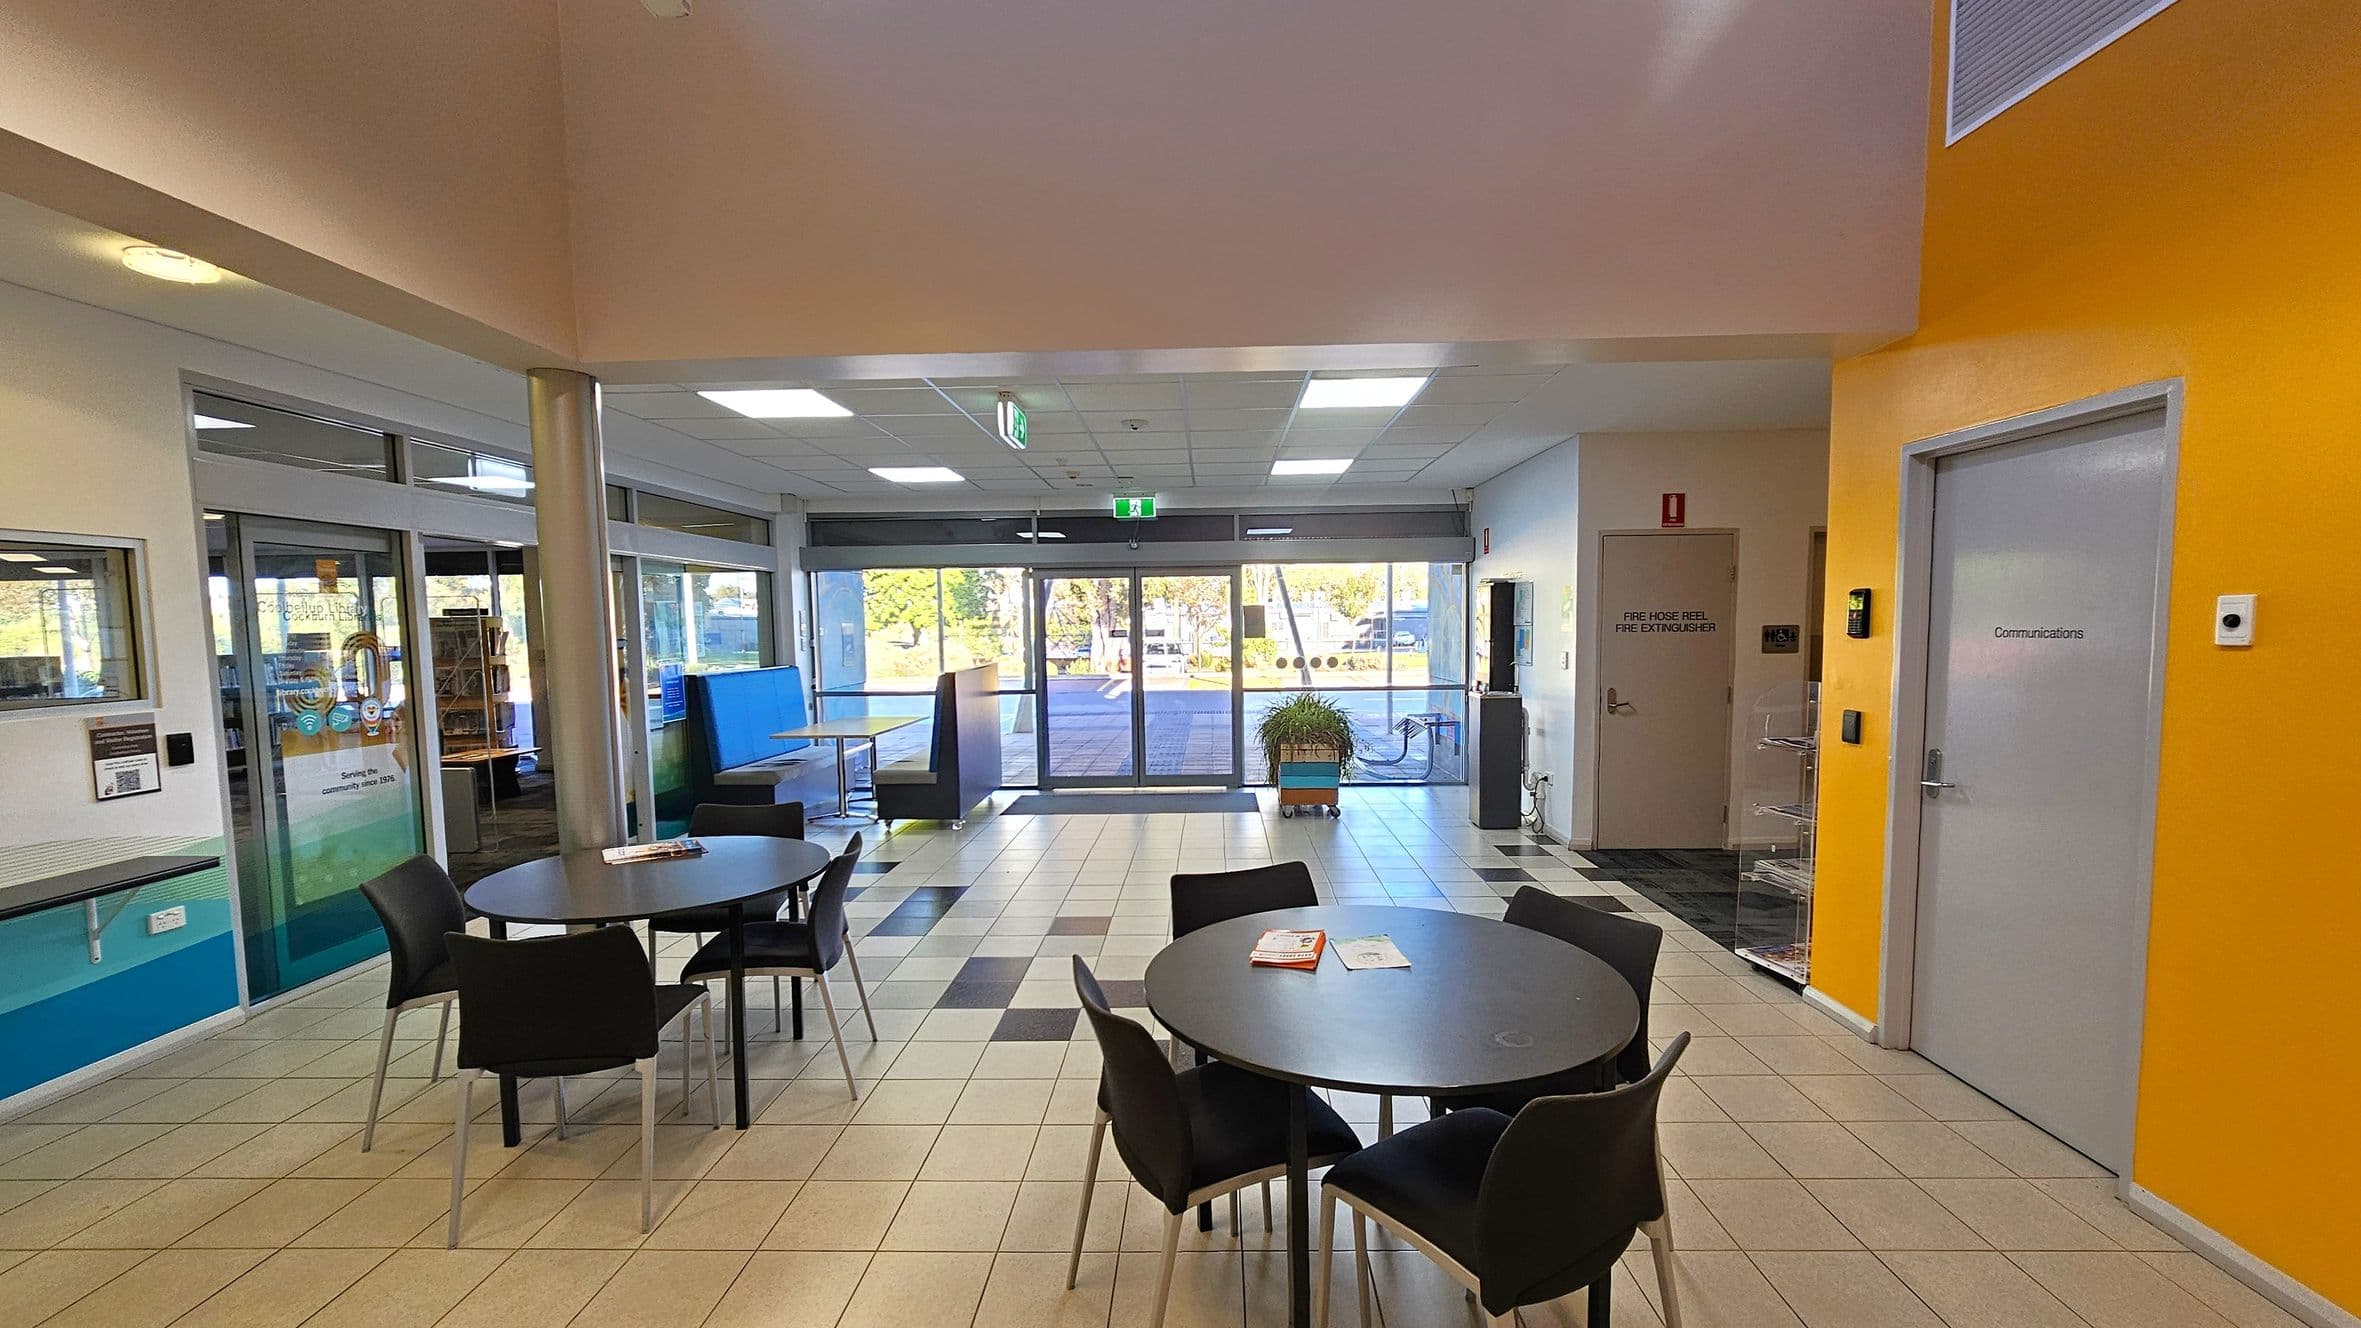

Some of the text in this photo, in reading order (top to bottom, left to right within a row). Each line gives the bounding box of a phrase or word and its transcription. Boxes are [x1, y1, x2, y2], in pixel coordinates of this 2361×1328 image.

[257, 601, 367, 617] Coolbellup Library
[1623, 611, 1709, 621] FIRE HOSE REEL
[1615, 623, 1717, 633] FIRE EXTINGUISHER
[1994, 626, 2085, 640] Communications
[341, 767, 378, 780] Serving the
[321, 782, 360, 796] community
[361, 779, 378, 788] since
